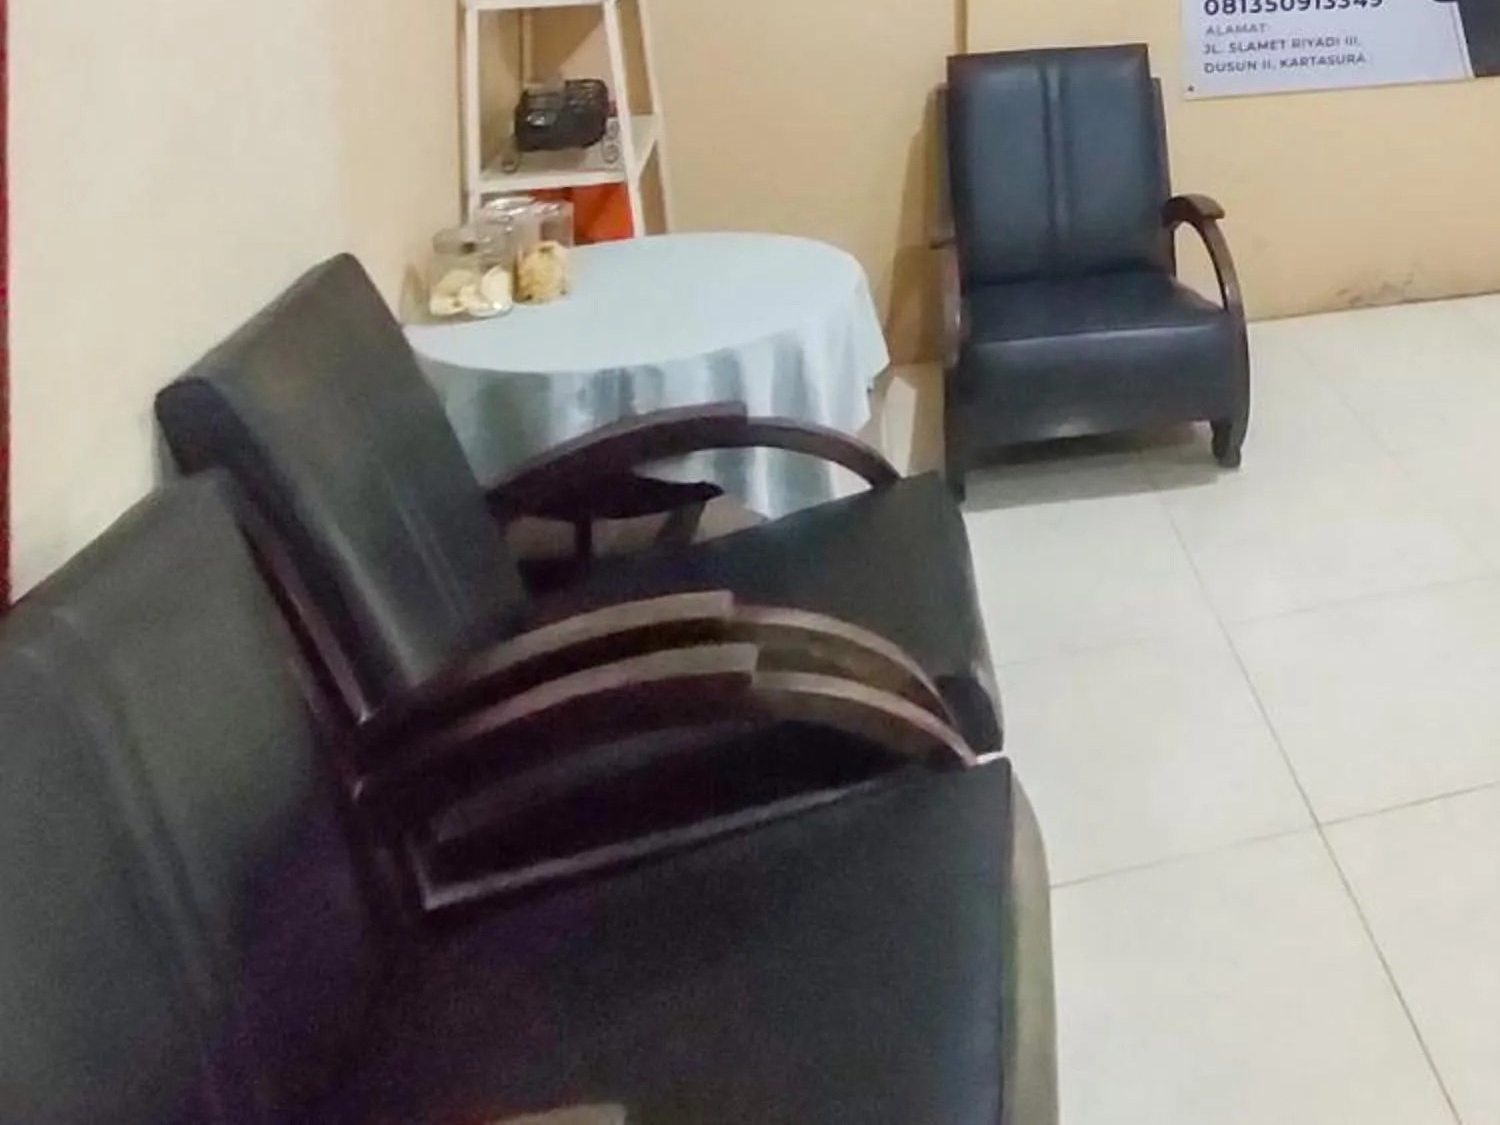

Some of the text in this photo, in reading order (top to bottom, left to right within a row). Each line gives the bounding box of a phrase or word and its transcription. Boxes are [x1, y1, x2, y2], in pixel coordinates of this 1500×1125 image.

[1230, 39, 1286, 54] SLAMET
[1291, 36, 1341, 50] RIYADI
[1204, 60, 1258, 74] DUSUN
[1279, 53, 1367, 69] KARTASURA
